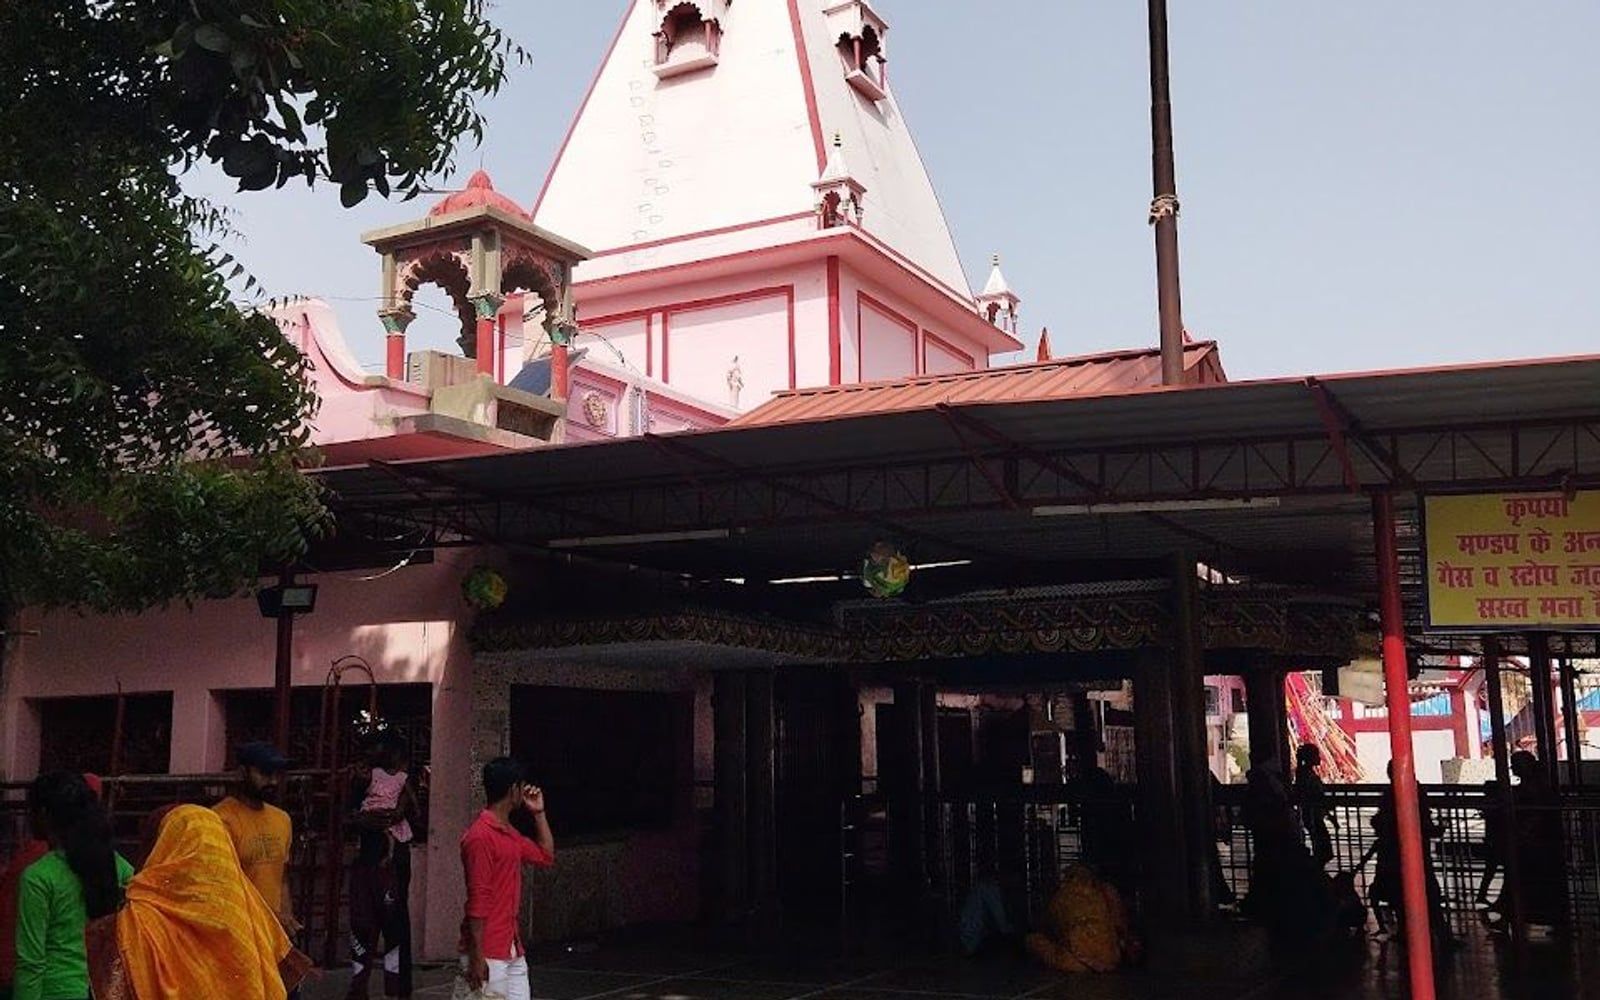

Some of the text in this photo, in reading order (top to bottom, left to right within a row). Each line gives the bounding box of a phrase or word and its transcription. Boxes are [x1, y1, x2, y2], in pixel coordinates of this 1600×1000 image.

[1503, 496, 1569, 526] कृपया
[1456, 534, 1520, 556] मण्डप
[1527, 527, 1552, 553] के
[1436, 561, 1474, 588] गैस
[1482, 566, 1501, 587] व
[1537, 596, 1584, 618] मना
